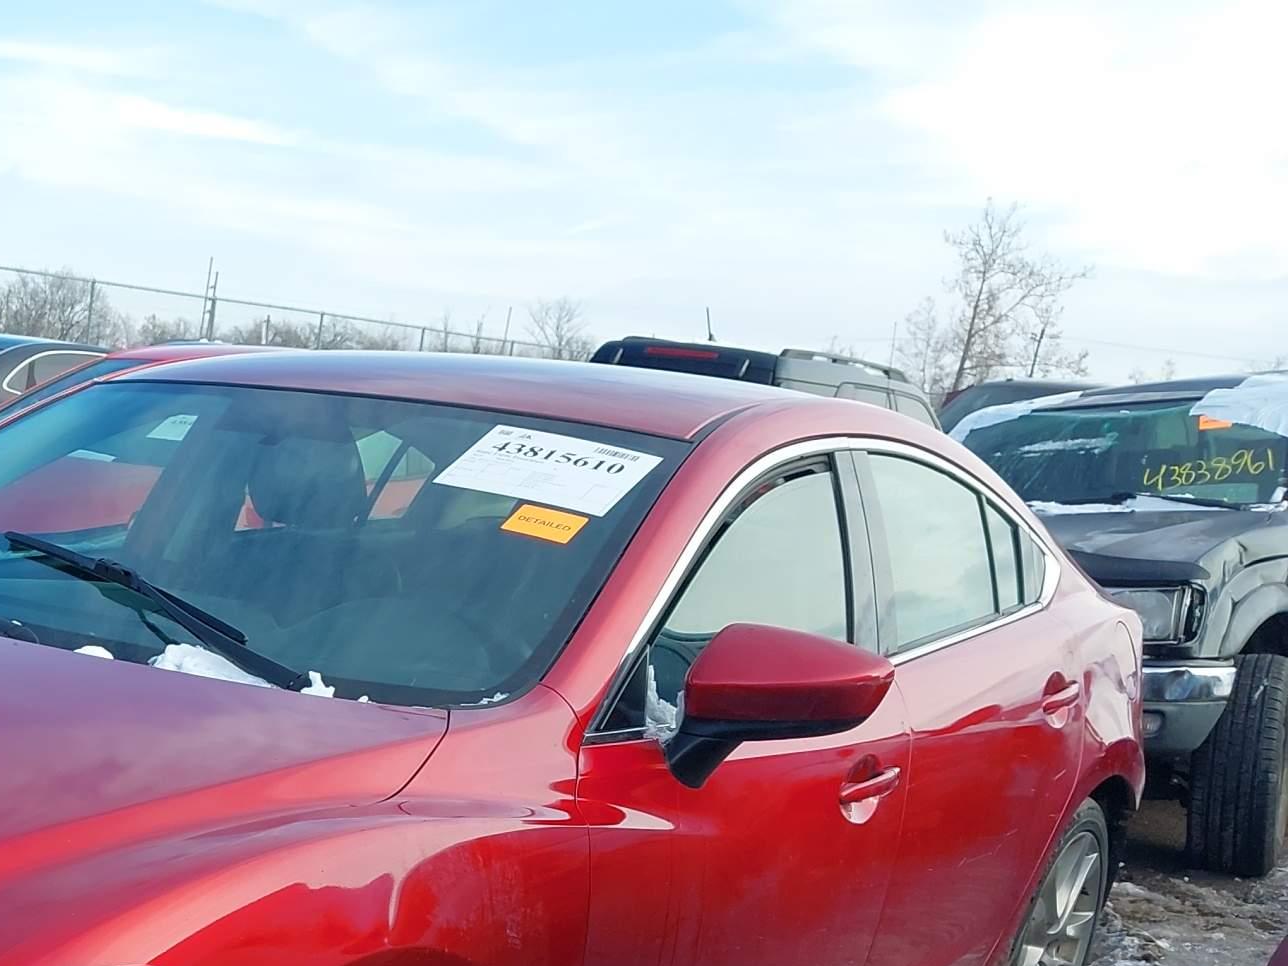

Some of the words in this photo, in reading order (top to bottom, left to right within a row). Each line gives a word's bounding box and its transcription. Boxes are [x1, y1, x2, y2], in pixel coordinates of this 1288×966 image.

[493, 441, 625, 475] 43815610
[1143, 448, 1275, 491] 43838961
[518, 515, 572, 532] DETAILED
